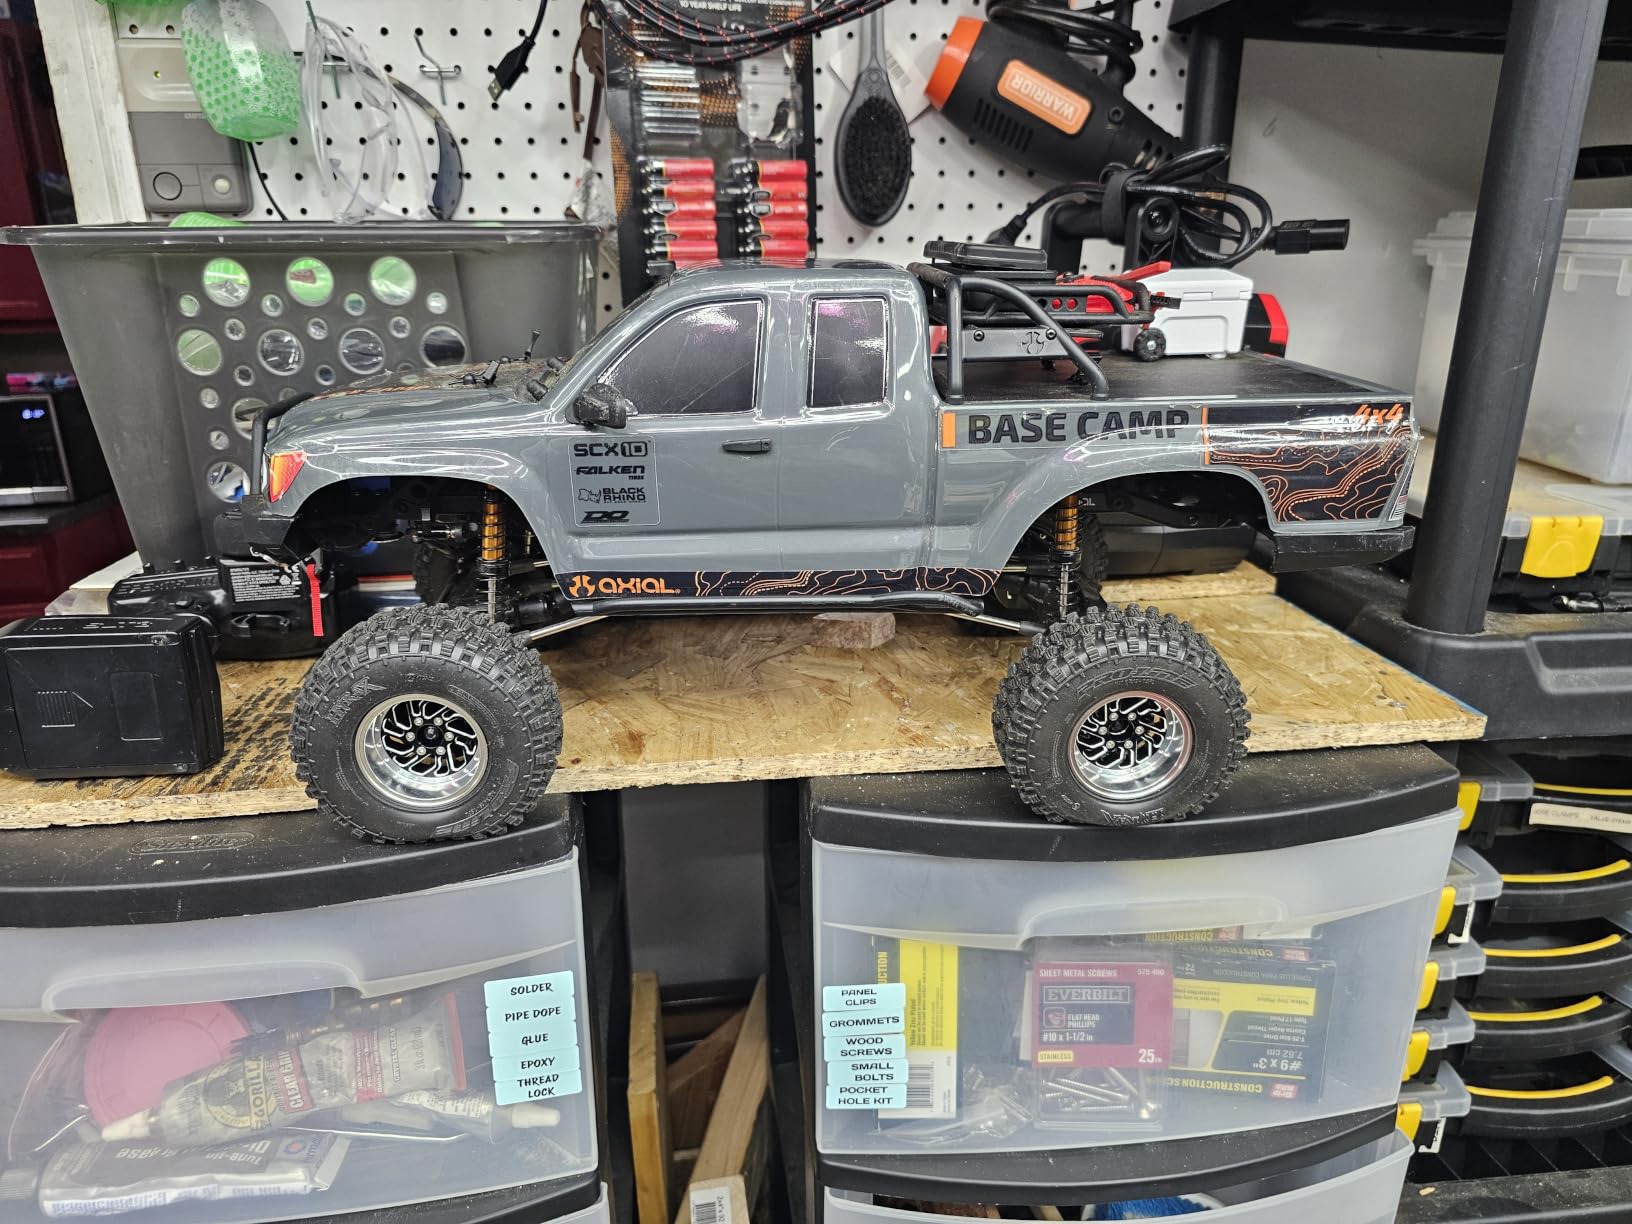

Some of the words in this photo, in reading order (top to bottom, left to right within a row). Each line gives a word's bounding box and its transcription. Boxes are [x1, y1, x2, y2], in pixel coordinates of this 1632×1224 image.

[1010, 74, 1074, 120] WARRIOR
[1354, 404, 1404, 424] 4x4
[968, 413, 1067, 444] BASE
[1077, 409, 1189, 441] CAMP
[573, 441, 648, 457] SCX10
[574, 465, 645, 475] FALKEN
[877, 952, 888, 984] UCTION
[1039, 968, 1061, 977] SHEET
[1063, 969, 1085, 977] METAL
[1087, 969, 1117, 977] SCREWS
[510, 982, 554, 996] SOLDER
[841, 989, 877, 997] PANEL
[1047, 989, 1127, 1001] EVERBILT
[845, 998, 877, 1006] CLIPS
[505, 1010, 530, 1022] PIPE
[532, 1006, 561, 1018] DOPE
[1067, 1013, 1084, 1021] FLAT
[1085, 1013, 1101, 1021] HEAD
[829, 1016, 900, 1028] GROMMETS
[1067, 1020, 1096, 1028] PHILLIPS
[521, 1033, 549, 1046] GLUE
[845, 1036, 884, 1045] WOOD
[1042, 1032, 1057, 1041] #10
[1066, 1031, 1085, 1041] 1-1/2
[840, 1048, 893, 1057] SCREWS
[1138, 1048, 1155, 1063] 25
[1281, 1049, 1303, 1059] 7.62
[277, 1050, 294, 1074] GRIP
[520, 1056, 555, 1070] EPOXY
[851, 1062, 894, 1071] SMALL
[1271, 1059, 1277, 1068] x
[1280, 1060, 1302, 1071] #9
[517, 1073, 560, 1088] THREAD
[855, 1073, 894, 1081] BOLTS
[246, 1056, 266, 1119] GORILLA
[283, 1073, 304, 1108] CLEAR
[839, 1086, 888, 1094] POCKET
[1182, 1078, 1263, 1093] CONSTRUCTION
[528, 1087, 556, 1098] LOCK
[838, 1097, 870, 1105] HOLE
[873, 1097, 893, 1105] KIT
